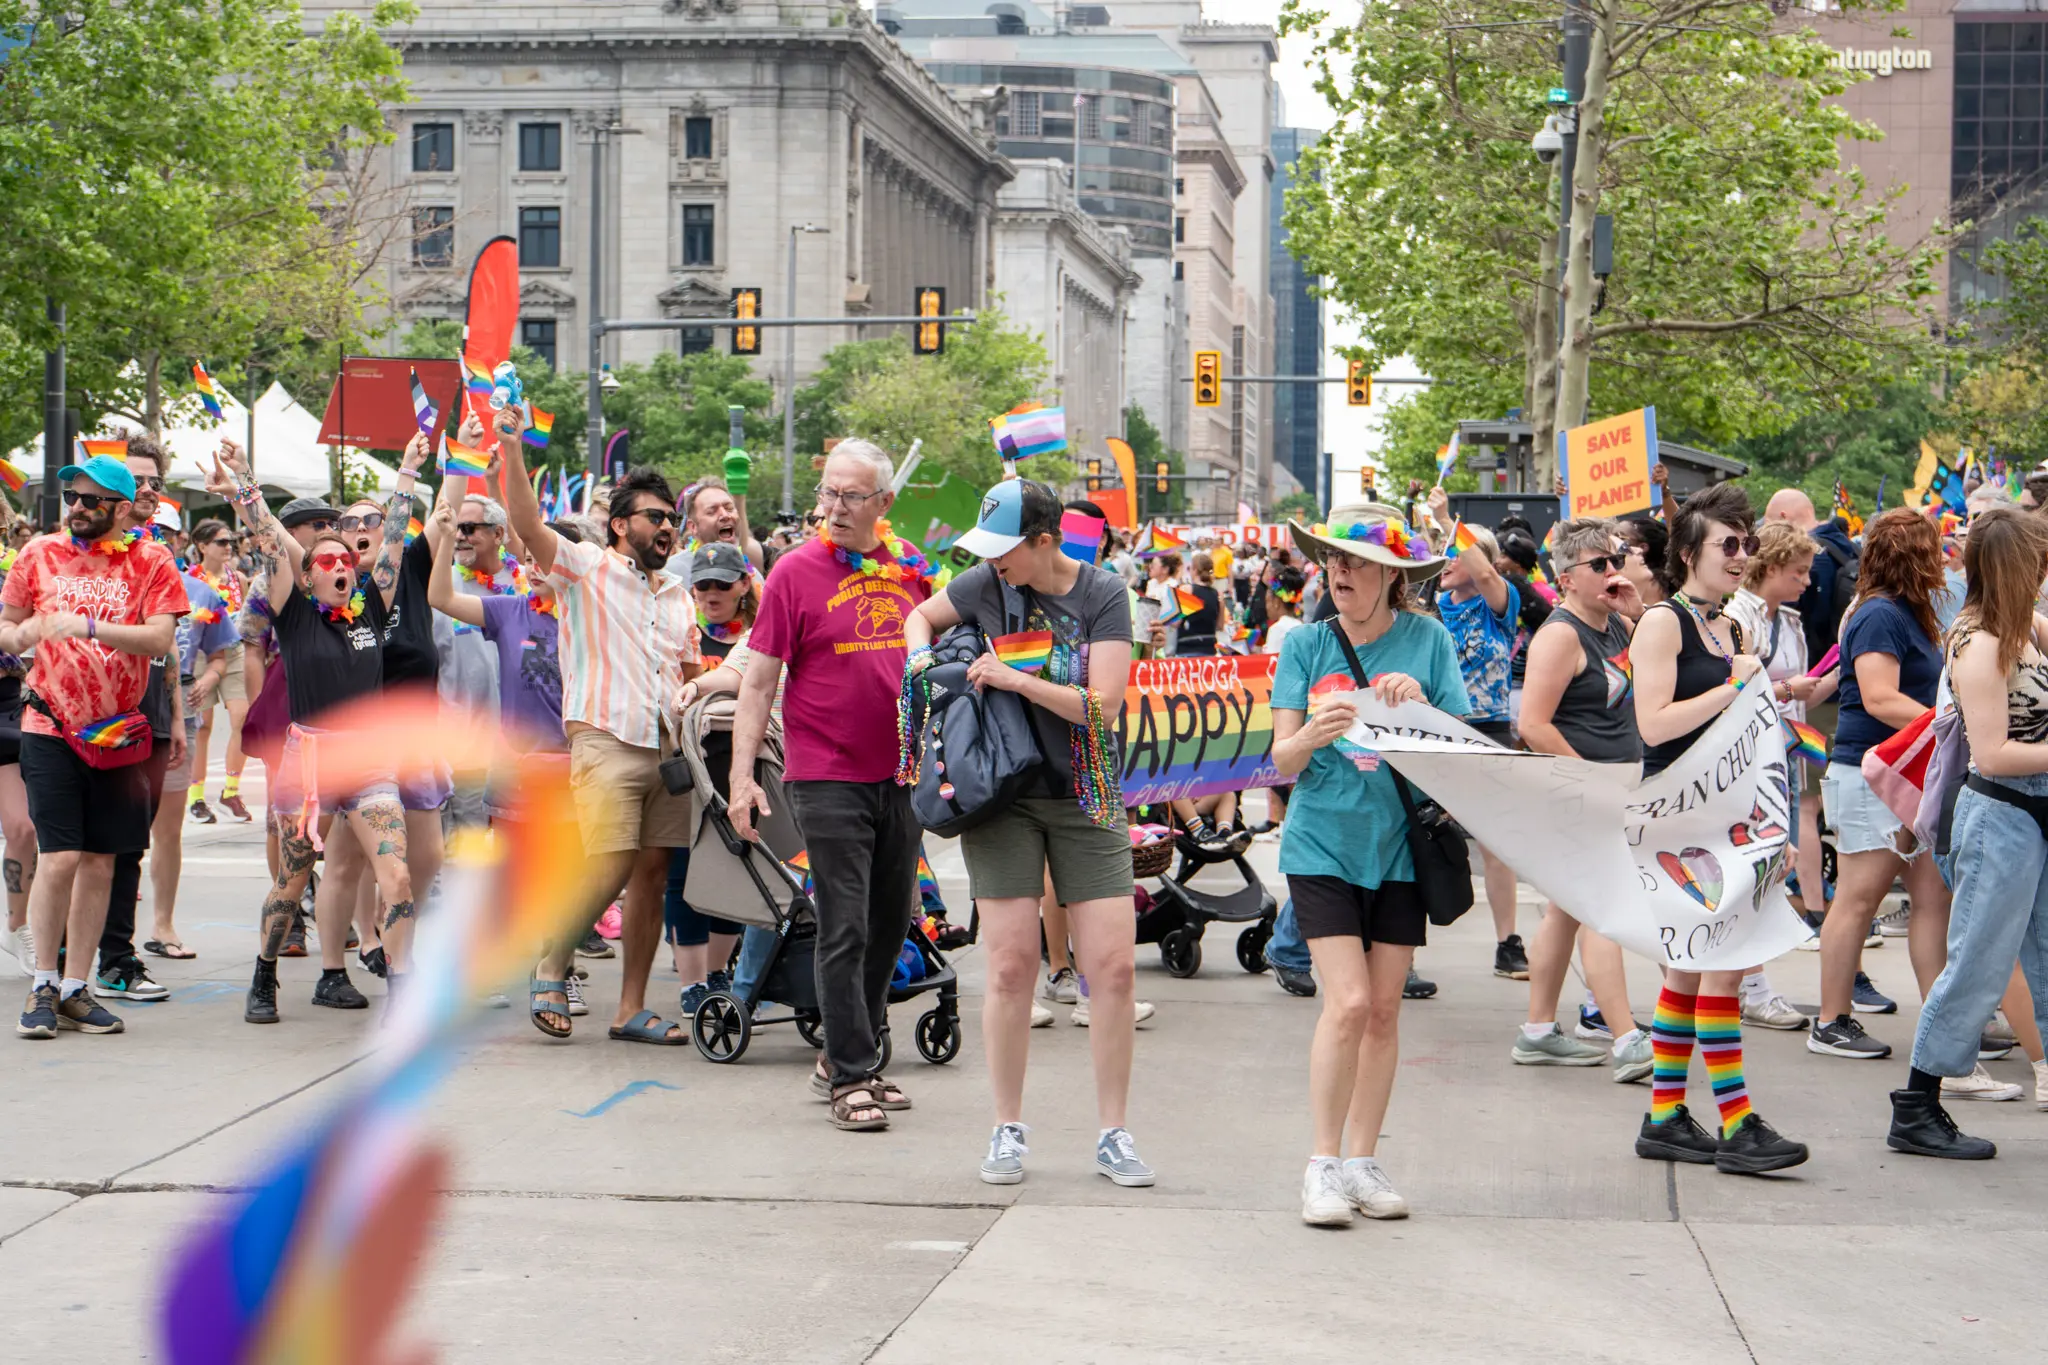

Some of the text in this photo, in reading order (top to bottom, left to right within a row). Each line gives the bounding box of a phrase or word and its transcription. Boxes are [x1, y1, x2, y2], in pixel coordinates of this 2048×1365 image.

[1823, 46, 1932, 76] ntington
[1587, 426, 1632, 454] SAVE
[1589, 456, 1628, 481] OUR
[1576, 480, 1644, 513] PLANET
[52, 575, 131, 602] DEFENDING
[826, 583, 864, 613] PUBLIC
[58, 600, 127, 625] OVE
[869, 641, 886, 651] LAST
[886, 638, 907, 649] CHAN
[1135, 657, 1244, 695] CUYAHOGA
